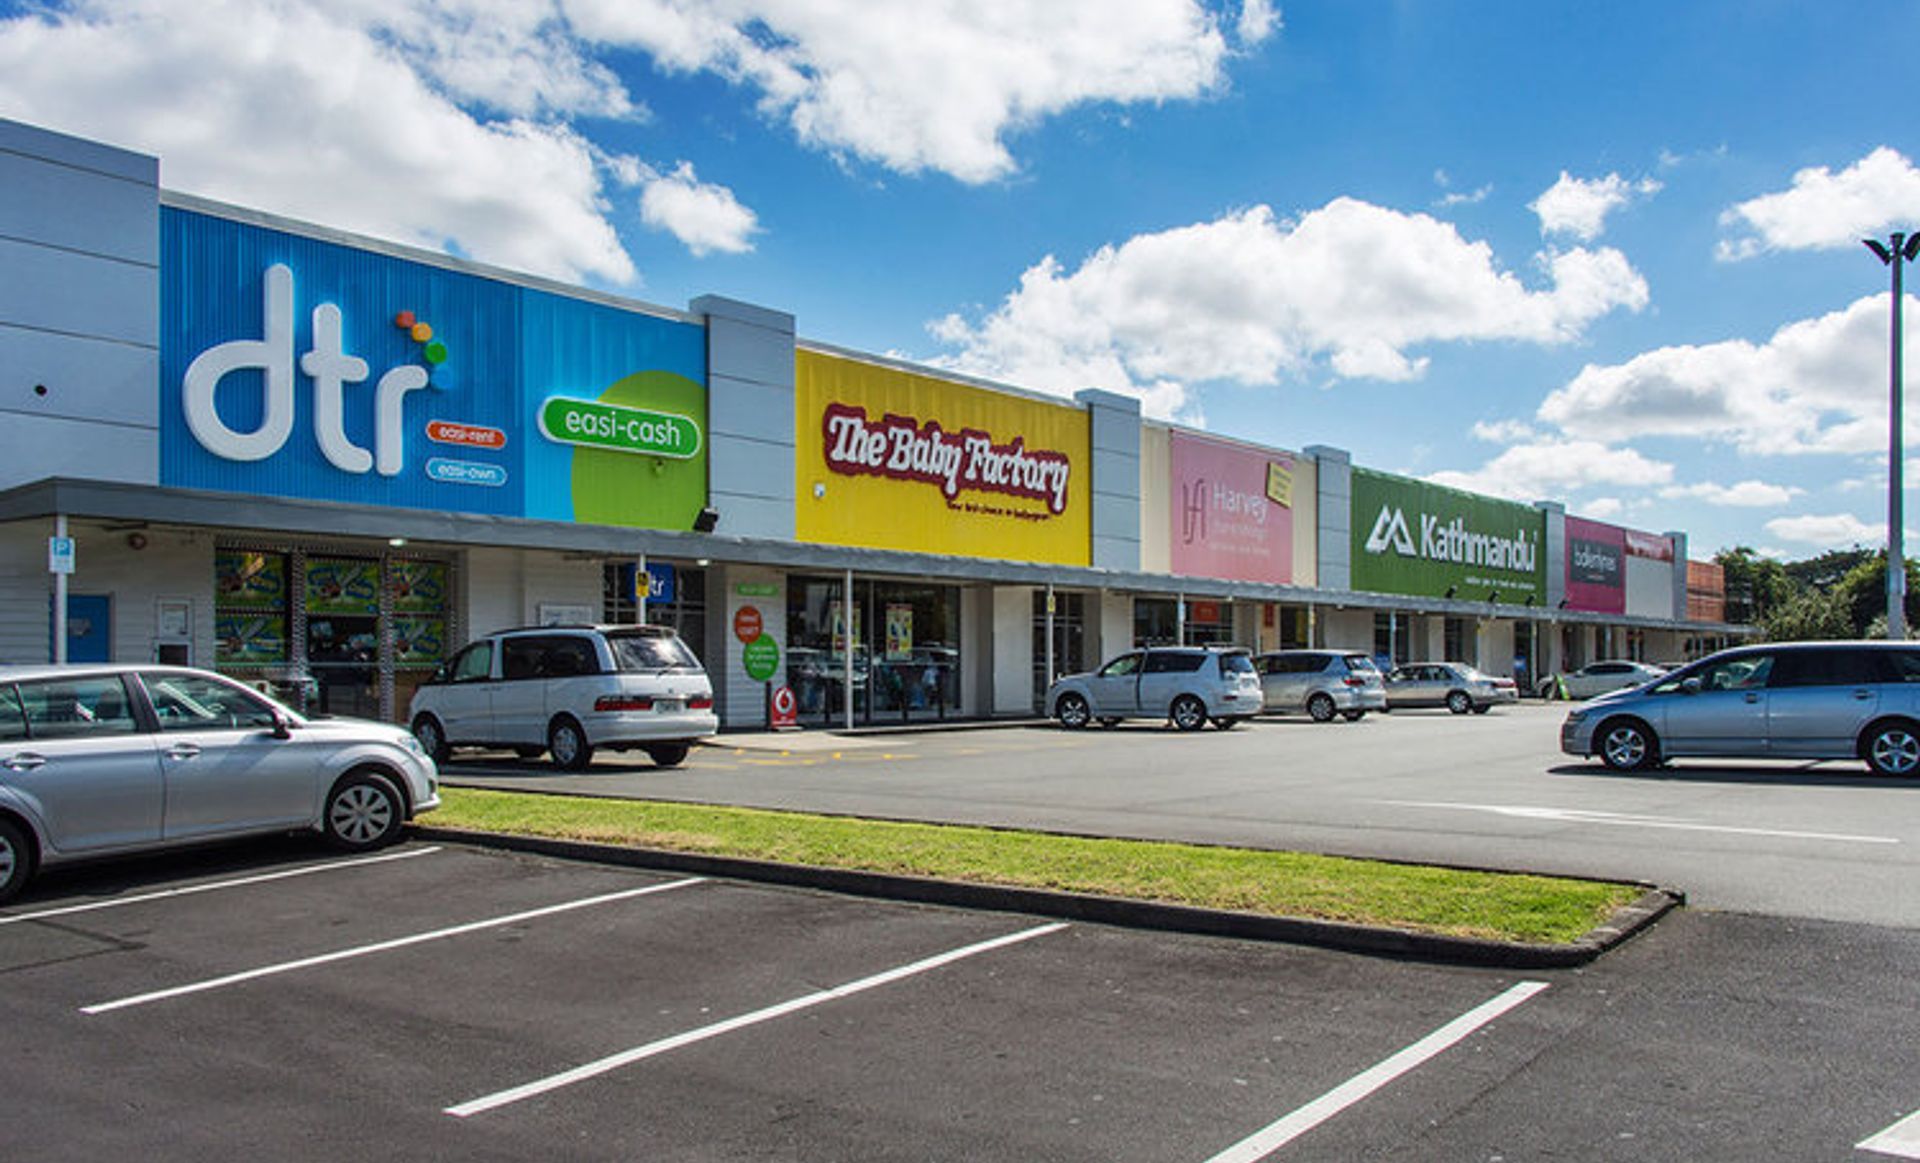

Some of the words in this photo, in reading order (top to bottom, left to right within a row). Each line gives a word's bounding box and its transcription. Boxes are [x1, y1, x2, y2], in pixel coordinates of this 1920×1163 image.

[182, 263, 429, 477] dtr
[565, 410, 680, 447] easi-cash
[828, 415, 887, 467] The
[886, 426, 962, 495] Baby
[965, 436, 1068, 512] Factory
[1212, 481, 1269, 526] Harvey
[1420, 512, 1537, 573] Kathmandu
